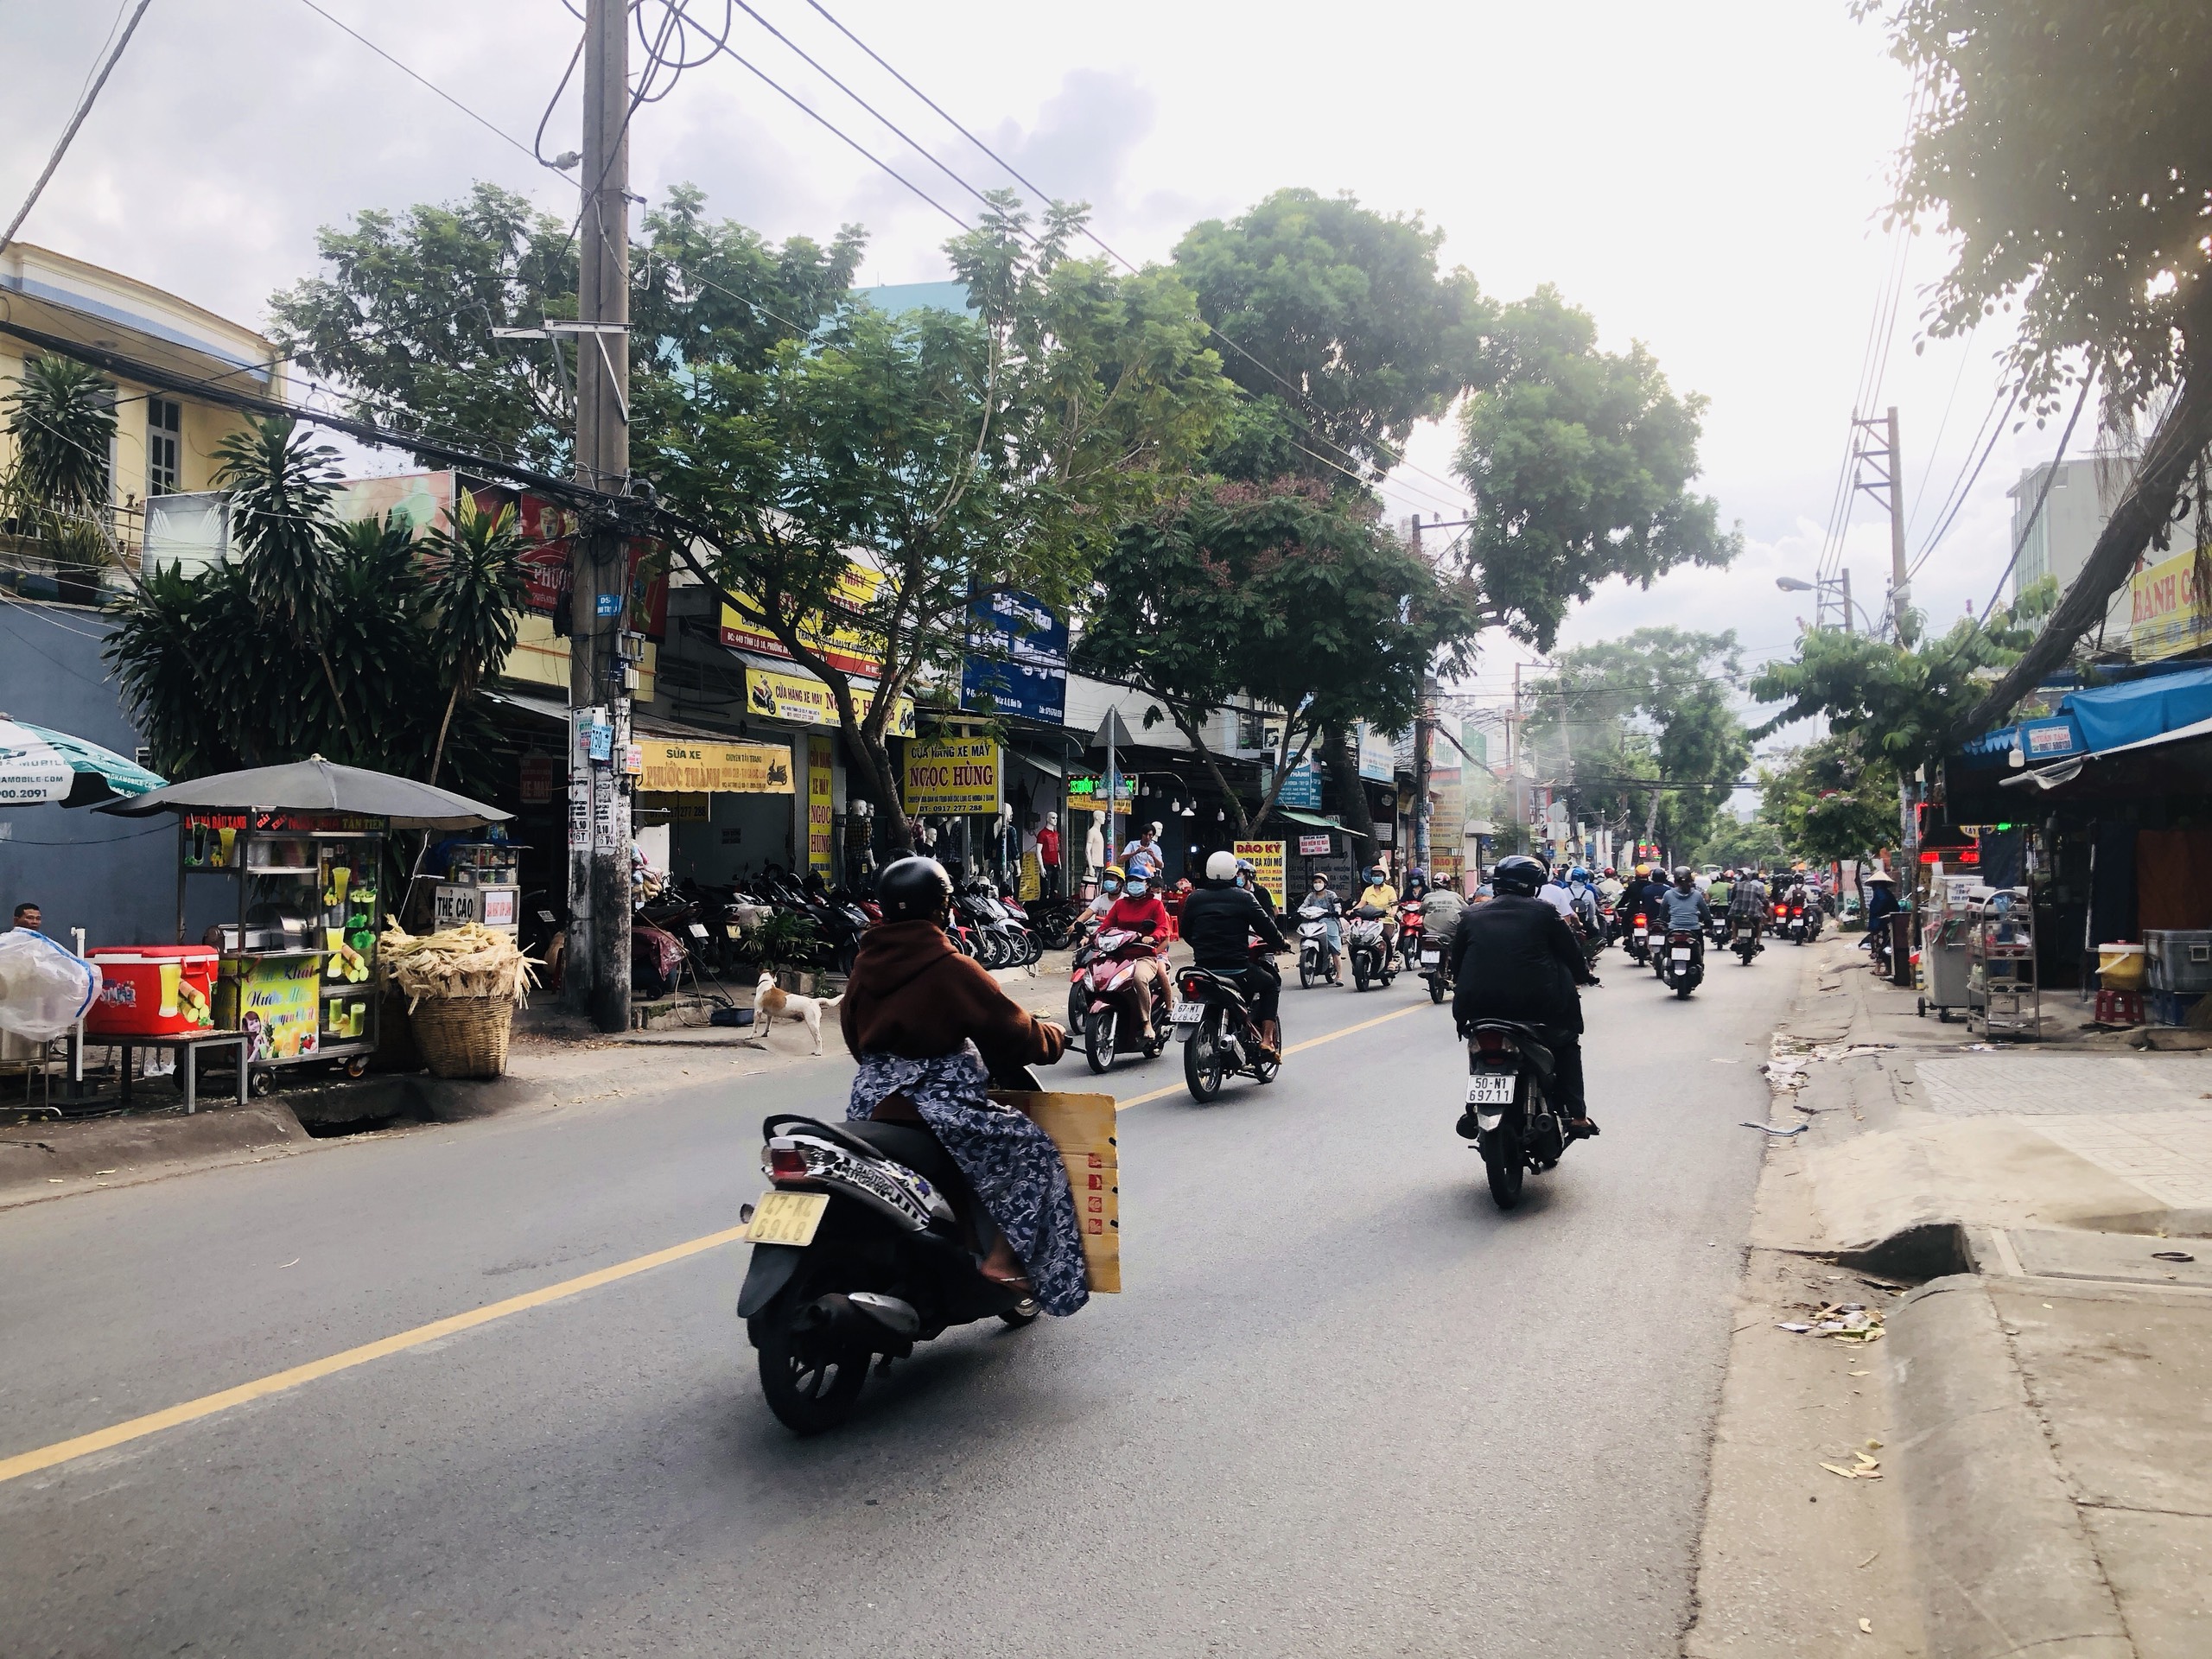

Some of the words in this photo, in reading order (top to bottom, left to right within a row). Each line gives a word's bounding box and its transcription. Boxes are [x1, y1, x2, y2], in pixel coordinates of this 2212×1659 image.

[2133, 574, 2177, 625] BÁNH
[775, 681, 787, 699] CỬA
[787, 685, 803, 702] HÀNG
[804, 690, 810, 702] XE
[666, 746, 687, 760] SỬA
[690, 750, 702, 760] XE
[911, 742, 929, 759] CỬA
[957, 746, 969, 758] XE
[971, 742, 992, 757] MÁY
[645, 760, 683, 788] PHƯỚC
[684, 762, 720, 788] THÀNH
[812, 778, 819, 794] XE
[819, 774, 830, 794] MÁY
[910, 766, 949, 791] NGỌC
[952, 760, 994, 786] HÙNG
[0, 789, 47, 798] 00.2091
[680, 806, 691, 817] 277
[694, 805, 706, 817] 288
[811, 804, 831, 830] NGỌC
[227, 815, 247, 830] XANH
[810, 830, 831, 853] HÙNG
[437, 889, 454, 917] THẺ
[456, 893, 474, 918] CÀO
[1475, 1077, 1507, 1090] 50-N1
[1469, 1090, 1510, 1102] 697.11
